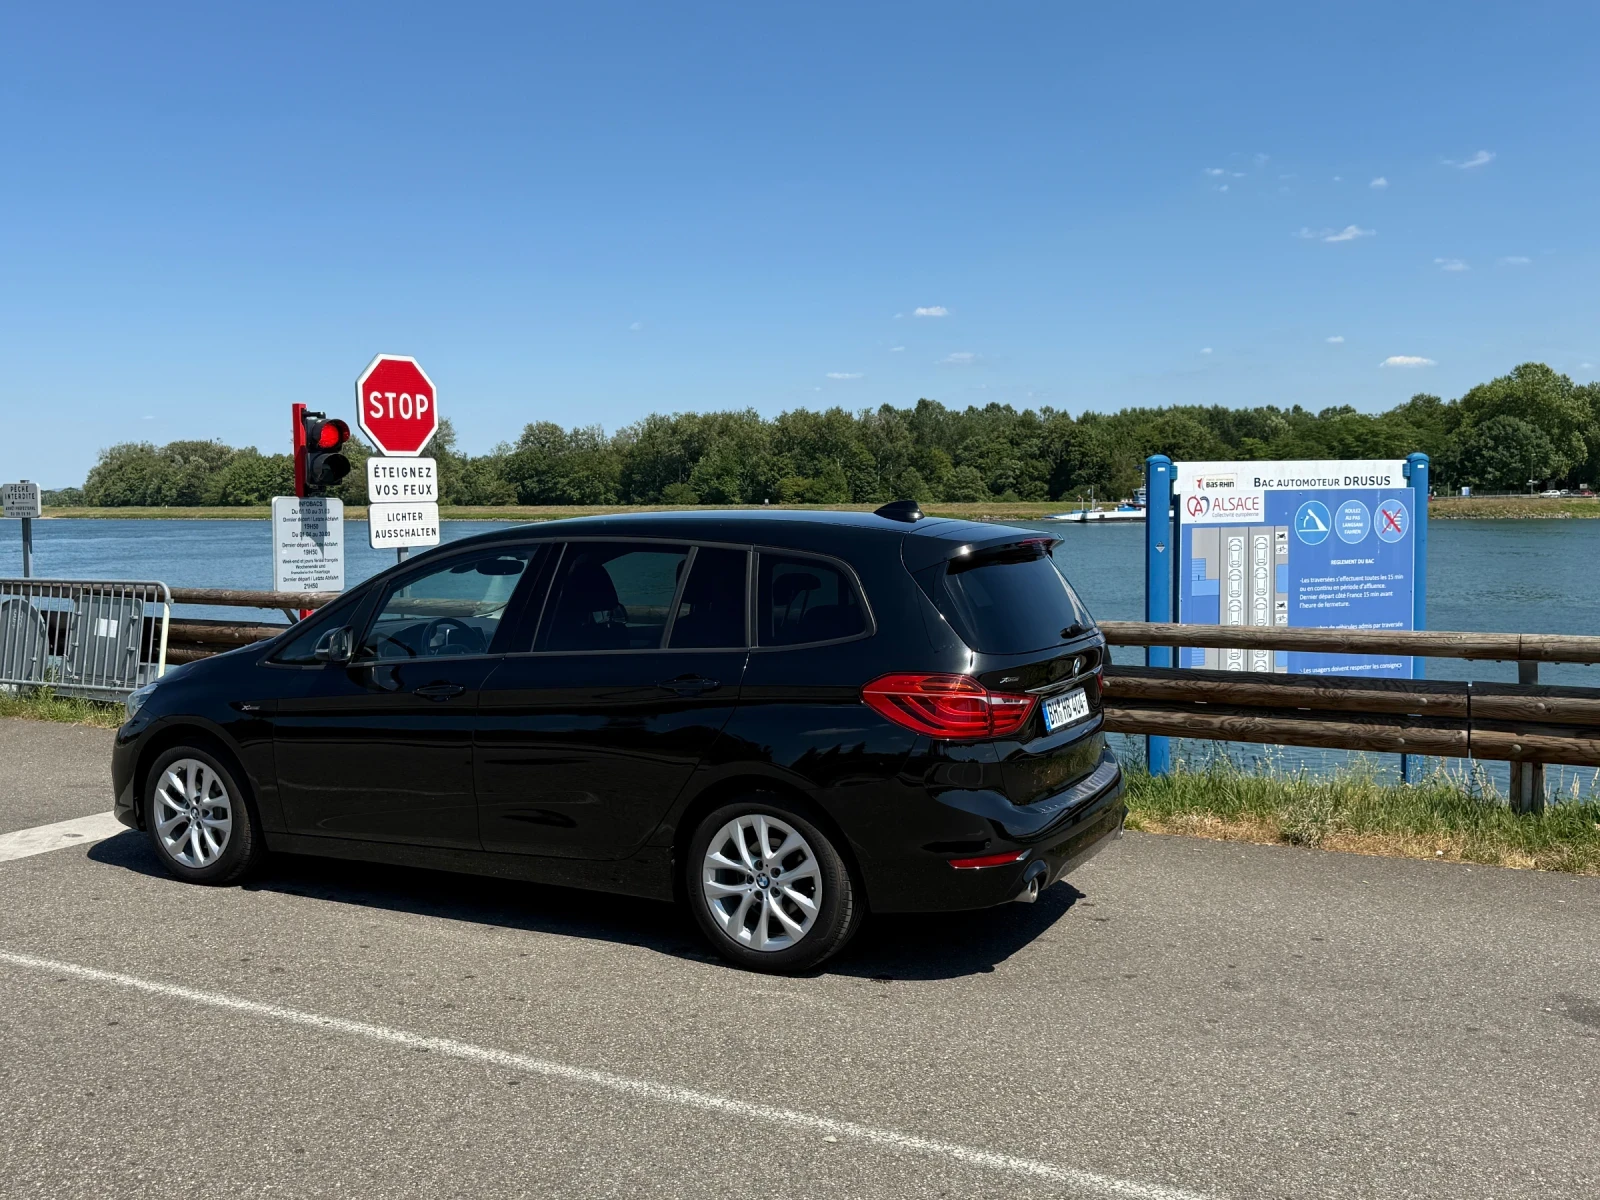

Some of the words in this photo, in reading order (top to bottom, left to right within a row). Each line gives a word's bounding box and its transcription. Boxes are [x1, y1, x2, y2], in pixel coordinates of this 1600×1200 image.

[370, 391, 428, 420] STOP
[374, 464, 432, 478] ÉTEIGNEZ
[1277, 478, 1340, 487] AUTOMOTEUR
[1344, 476, 1390, 486] DRUSUS
[375, 484, 398, 496] VOS
[404, 484, 432, 495] FEUX
[1212, 496, 1259, 511] ALSACE
[387, 512, 423, 522] LICHTER
[375, 528, 437, 538] AUSSCHALTEN
